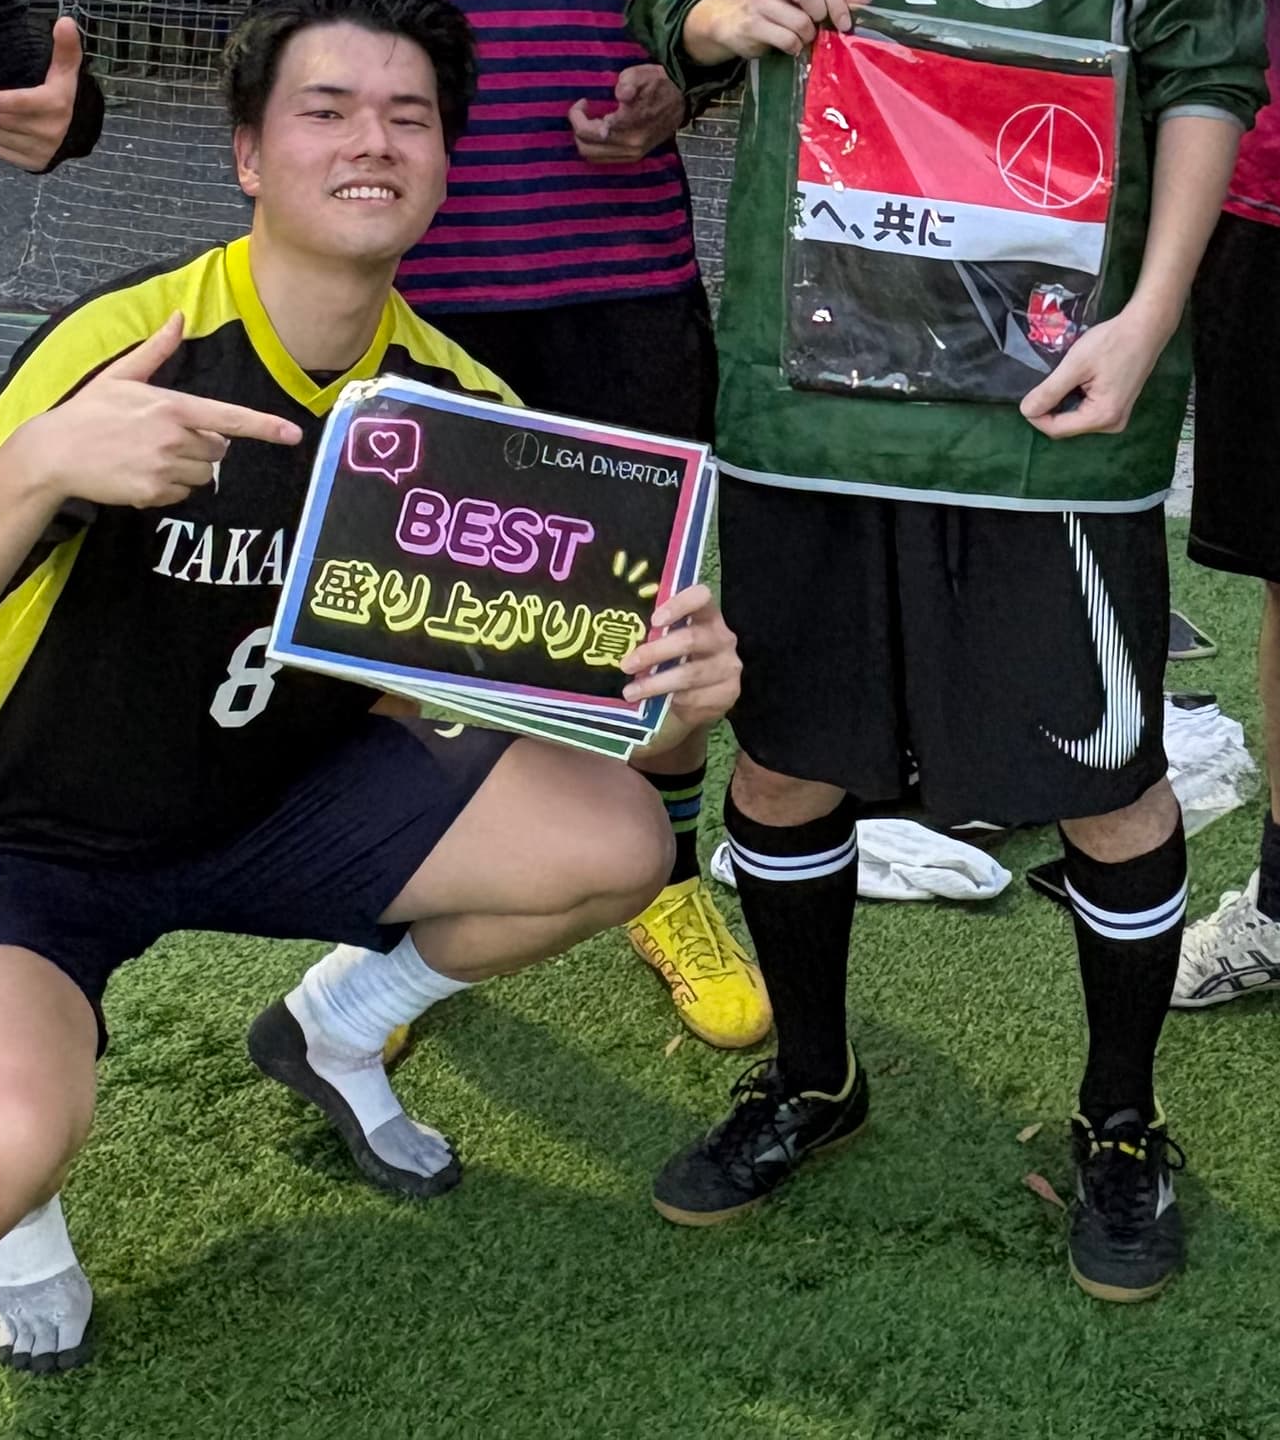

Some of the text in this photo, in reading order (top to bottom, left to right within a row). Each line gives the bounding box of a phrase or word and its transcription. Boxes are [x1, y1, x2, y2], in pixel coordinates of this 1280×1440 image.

[151, 516, 285, 586] TAKA
[395, 487, 596, 582] BEST
[311, 560, 647, 668] 盛り上がり賞
[210, 626, 283, 729] 8
